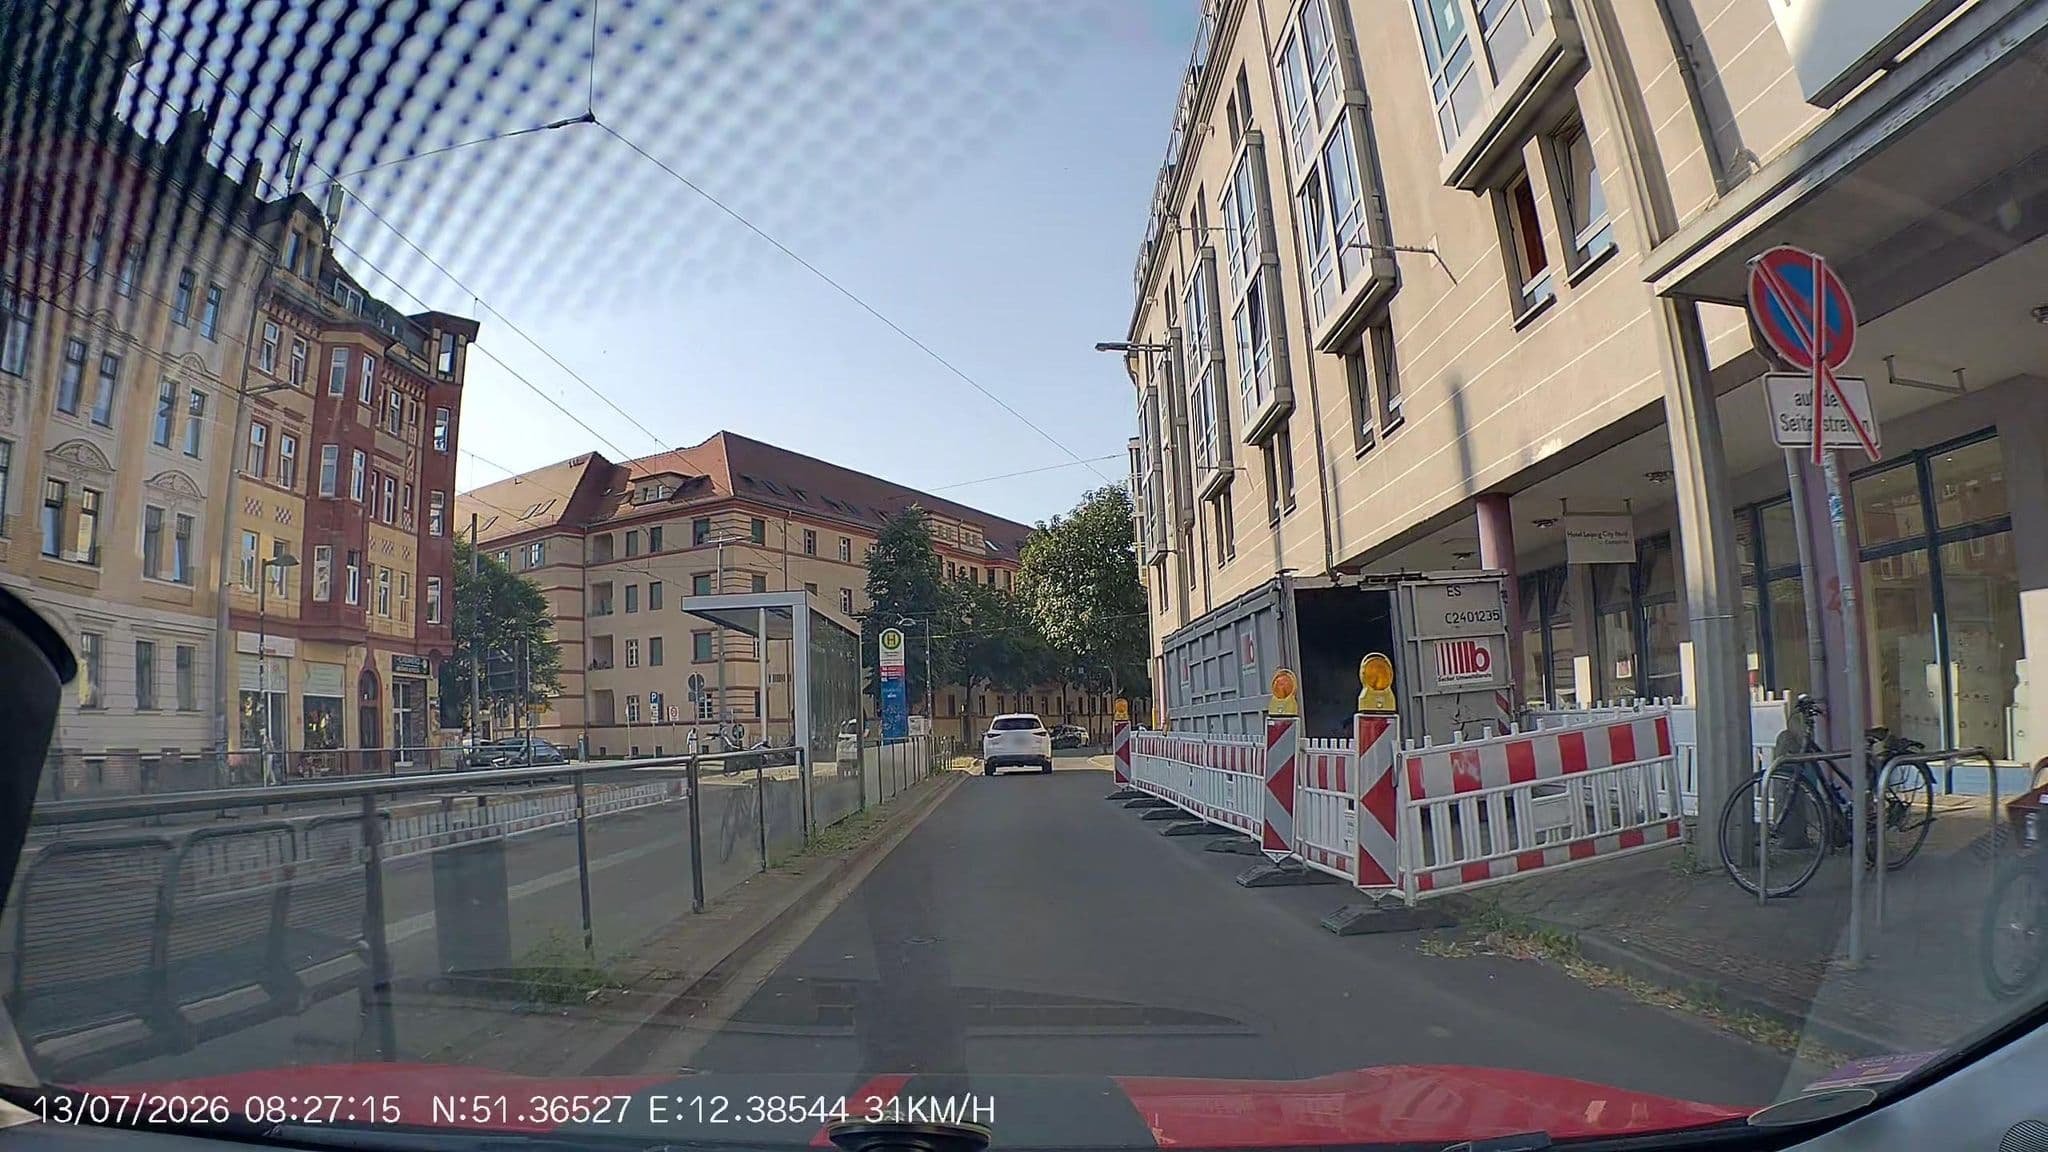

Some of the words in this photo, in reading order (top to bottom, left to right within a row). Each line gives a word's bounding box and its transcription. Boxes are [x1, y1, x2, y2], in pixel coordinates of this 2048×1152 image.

[1446, 585, 1462, 597] ES
[1445, 609, 1500, 624] C2401235
[887, 634, 896, 645] H
